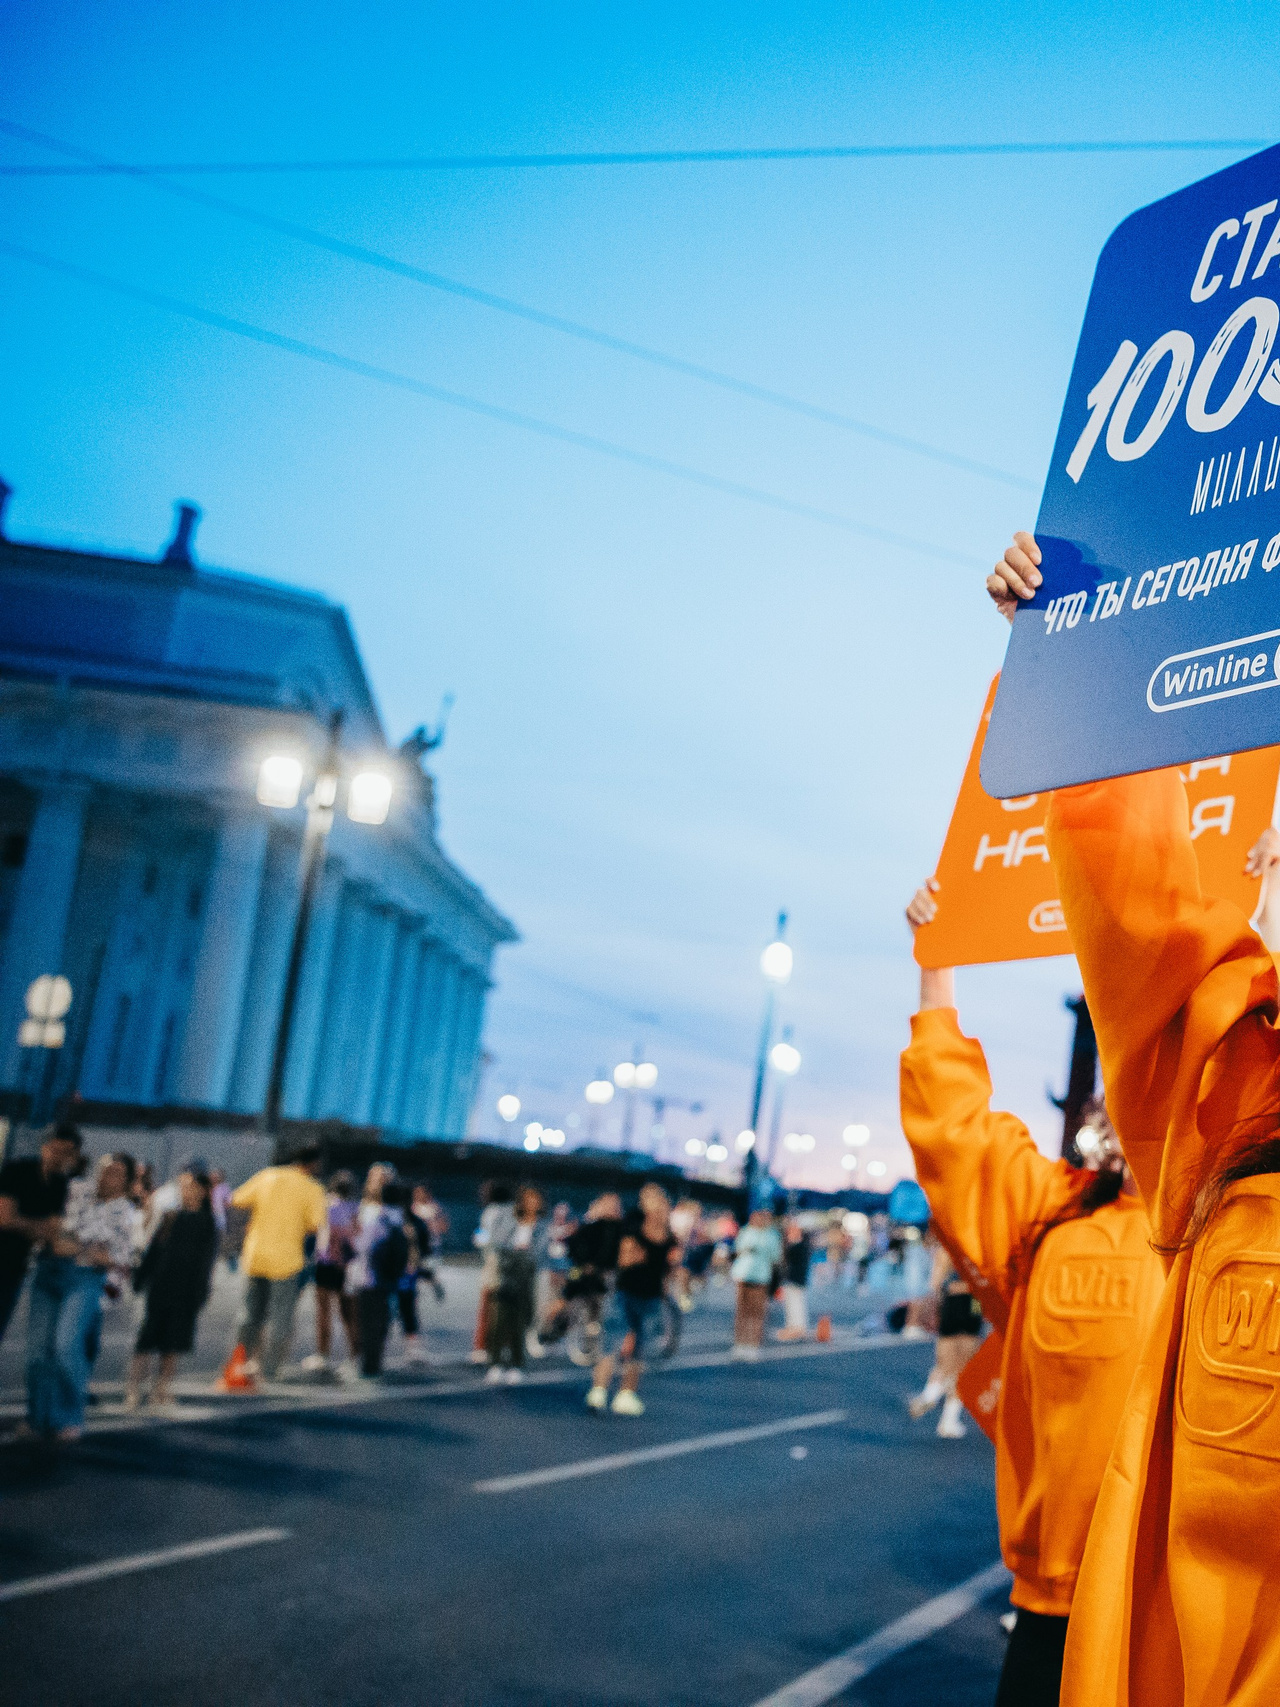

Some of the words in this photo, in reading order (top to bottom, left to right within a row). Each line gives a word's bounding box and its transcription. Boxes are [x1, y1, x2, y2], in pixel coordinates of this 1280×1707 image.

[1044, 590, 1088, 635] ЧТО
[1089, 576, 1131, 622] ТЫ
[1131, 539, 1258, 610] СЕГОДНЯ
[1164, 654, 1268, 698] Winline
